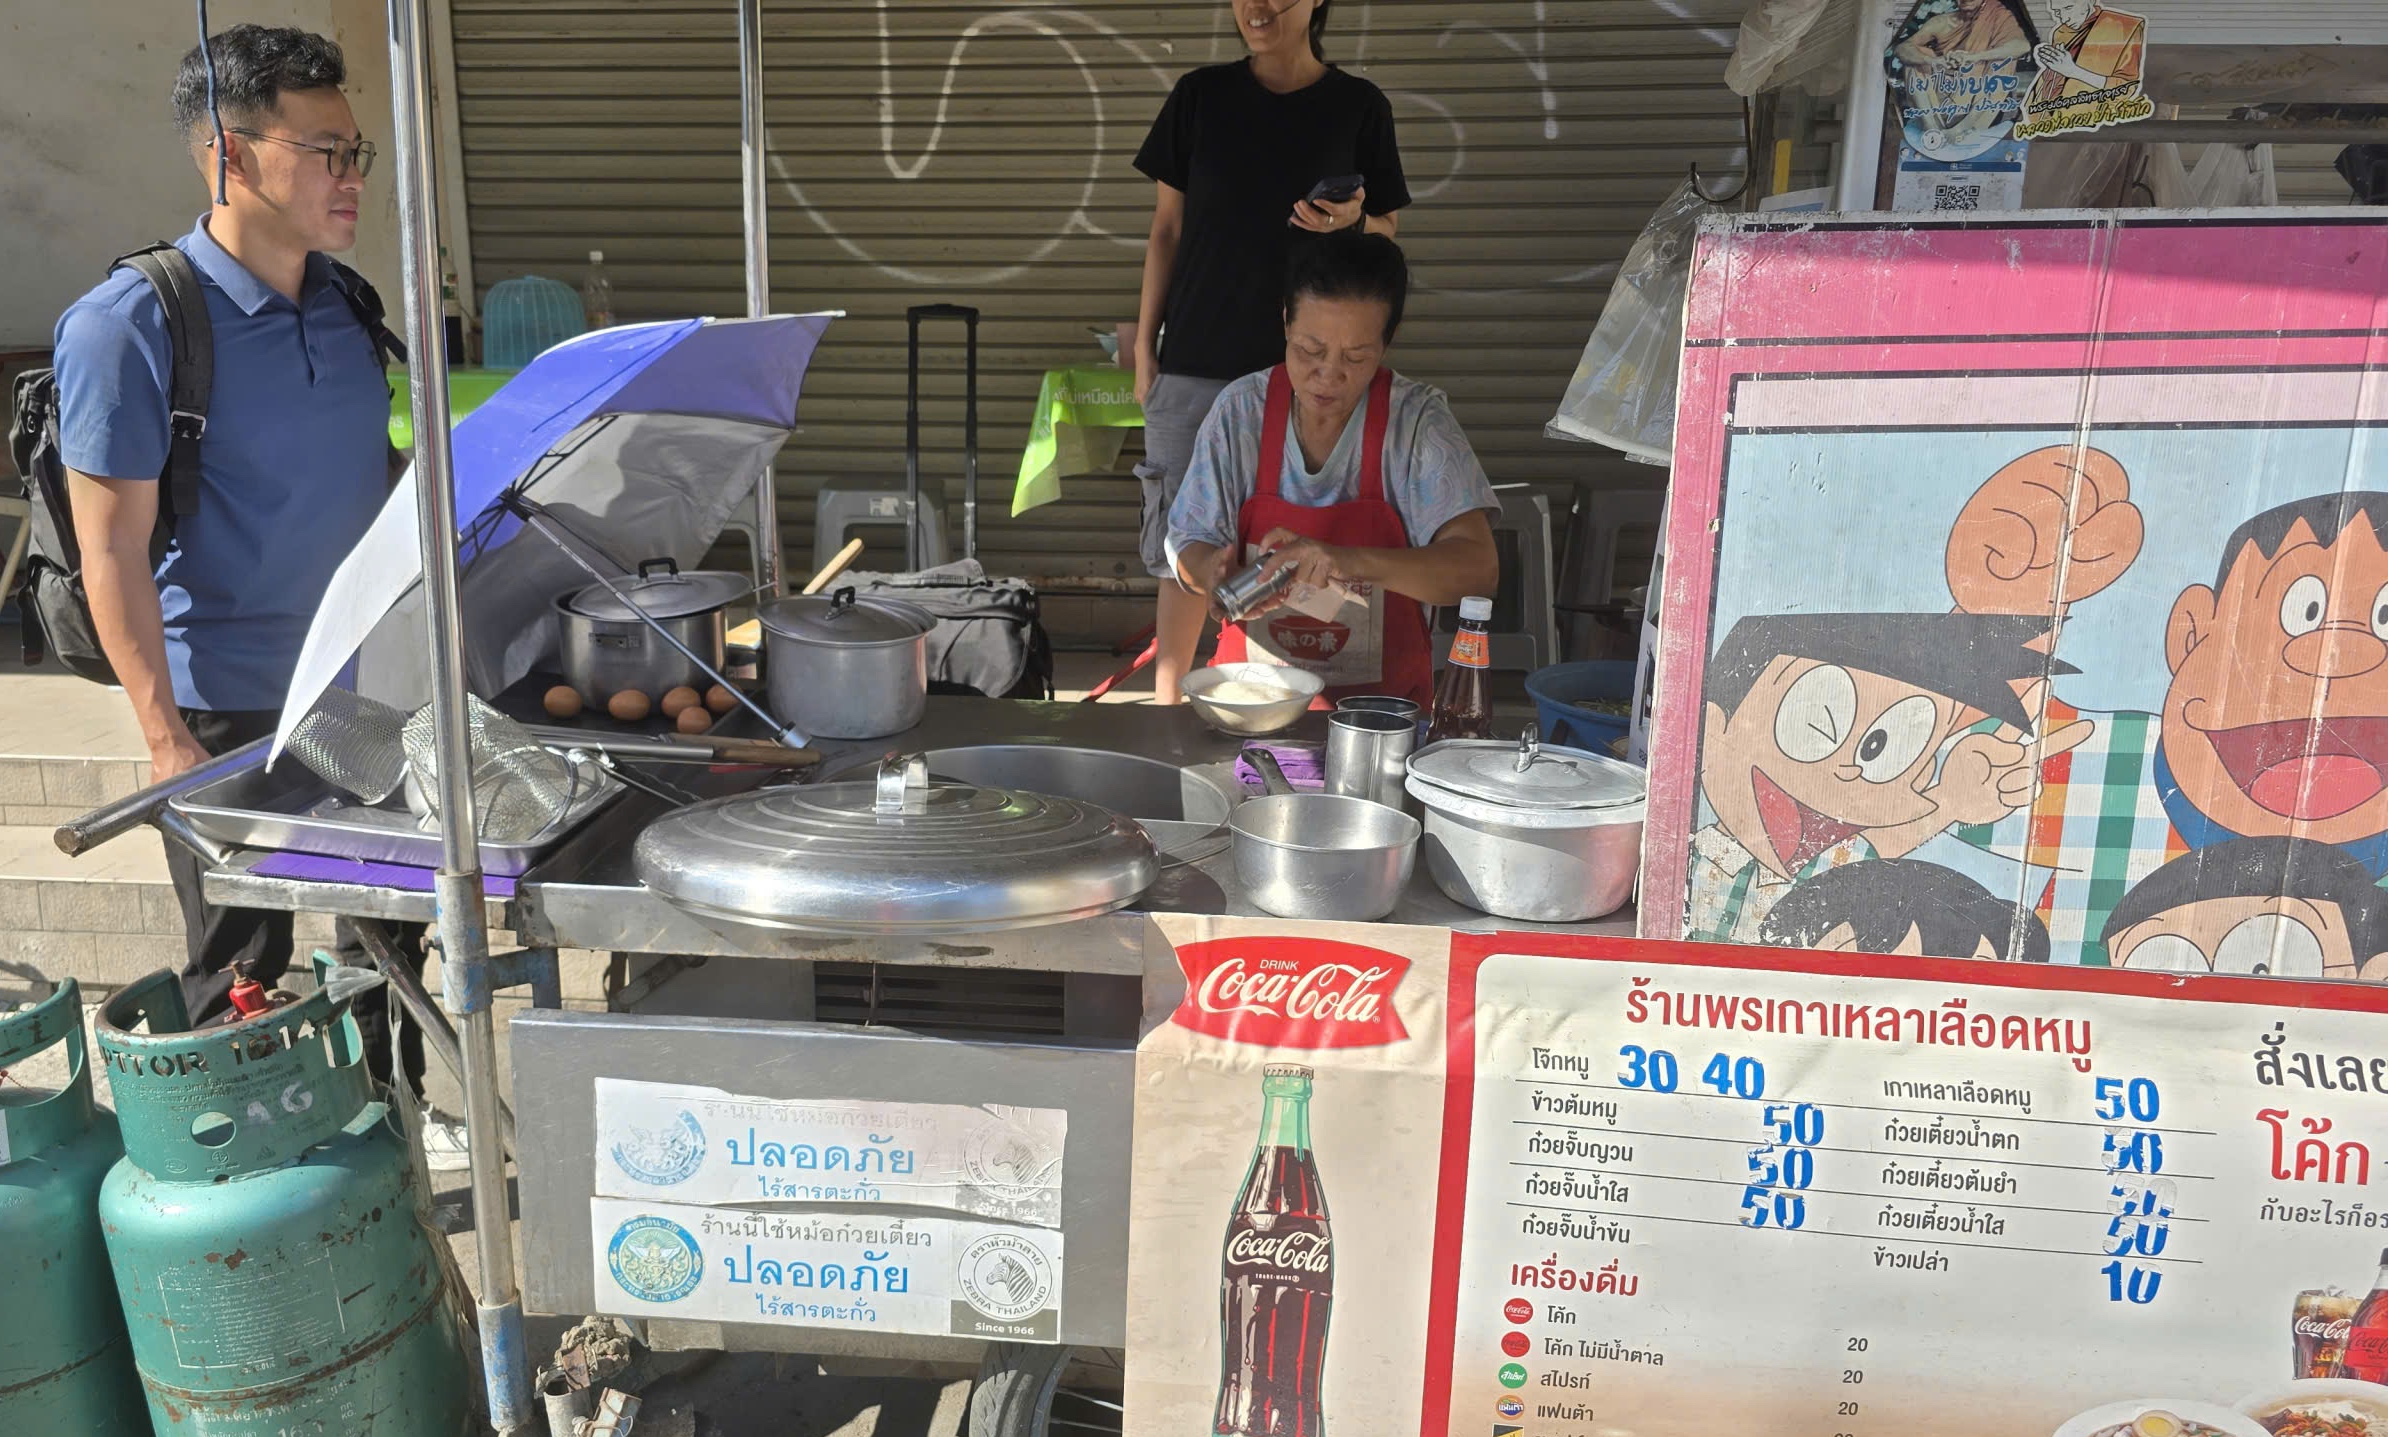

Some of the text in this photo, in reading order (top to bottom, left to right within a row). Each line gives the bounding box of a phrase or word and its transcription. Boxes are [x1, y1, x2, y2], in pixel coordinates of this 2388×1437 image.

[1260, 959, 1298, 971] DRINK
[1199, 957, 1392, 1024] Coca-Cola
[1626, 977, 2092, 1072] ร้านพรเกาเหลาเลือดหมู
[1533, 1044, 1764, 1100] โจ๊กหมู 30 40
[1532, 1092, 1825, 1146] ข้าวต้มหมู 50
[1884, 1076, 2160, 1122] เกาเหลาเลือดหมู 50
[726, 1127, 914, 1175] ปลอดภัย
[1885, 1115, 2020, 1152] ก๋วยเตี๋ยวน้ำตก
[2256, 1109, 2370, 1186] โค้ก
[1528, 1130, 1814, 1190] ก๋วยจั๊บญวน 50
[1882, 1157, 2017, 1194] ก๋วยเตี๋ยวต้มยำ
[758, 1175, 881, 1201] ไร้สารตะกั่ว
[1525, 1172, 1806, 1230] ก๋วยจั๊บน้ำใส 50
[700, 1213, 932, 1248] ร้านนี้ใช้หม้อก๋วยเตี๋ยว
[1012, 1206, 1037, 1216] 1966
[1522, 1213, 1630, 1244] ก๋วยจั๊บน้ำข้น
[1878, 1201, 2005, 1236] ก๋วยเตี๋ยวน้ำใส
[724, 1244, 908, 1293] ปลอดภัย
[1227, 1229, 1331, 1272] Coca-Cola
[964, 1278, 1046, 1315] ZEBRA THAILAND
[1511, 1252, 1638, 1297] เครื่องดื่ม
[1874, 1244, 2163, 1304] ข้าวเปล่า 10
[756, 1294, 877, 1322] ไร้สารตะกั่ว
[975, 1322, 1034, 1335] Since 1966
[1547, 1305, 1868, 1352] โค้ก 20
[1544, 1338, 1573, 1357] โค้ก
[1578, 1339, 1664, 1366] ไม่มีน้ำตาล
[1842, 1369, 1863, 1384] 20
[1537, 1403, 1594, 1421] แฟนต้า
[1540, 1370, 1859, 1415] สไปรท์ 20
